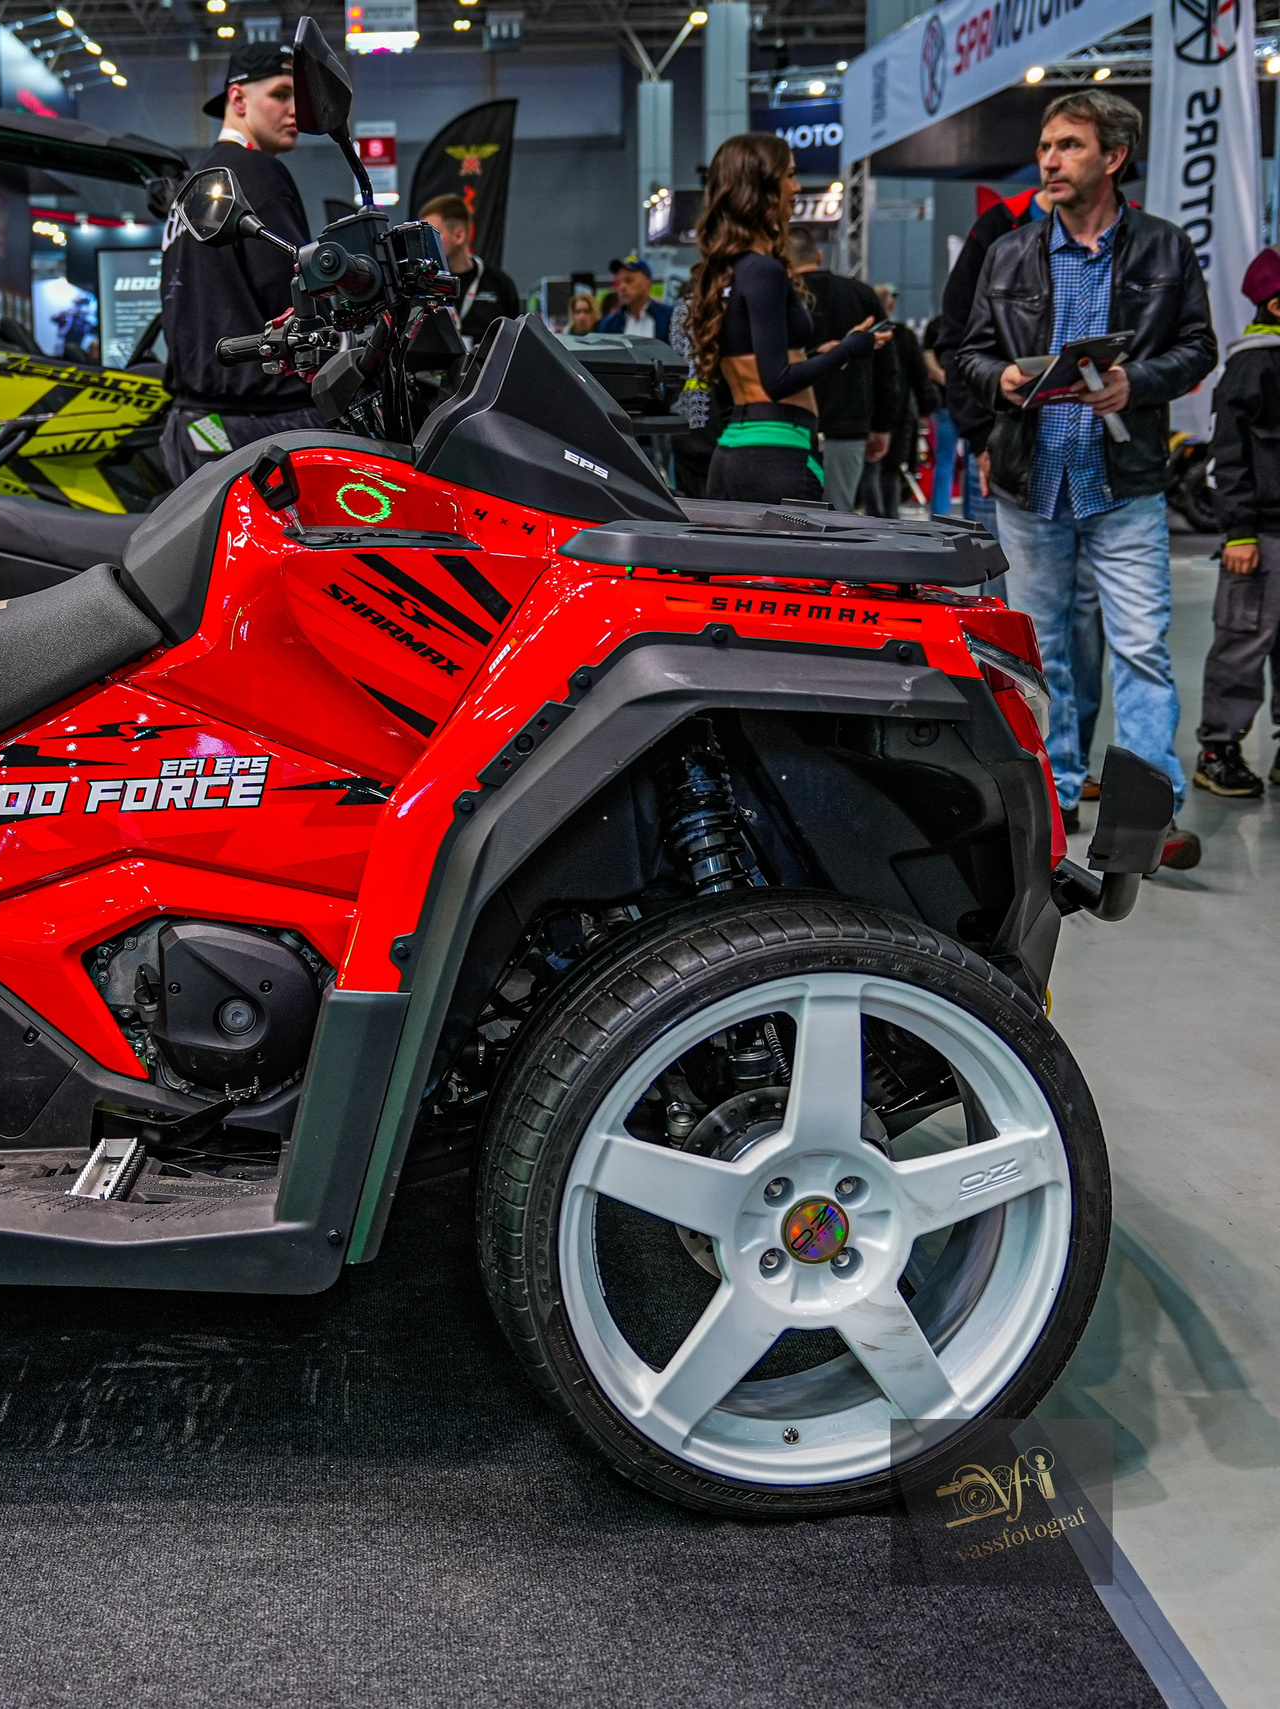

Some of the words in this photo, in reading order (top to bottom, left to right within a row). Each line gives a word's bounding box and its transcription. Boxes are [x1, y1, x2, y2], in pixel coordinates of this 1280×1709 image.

[954, 0, 1085, 74] SPRMOTO
[793, 200, 840, 216] OTO
[564, 449, 609, 480] EPS
[710, 597, 880, 625] SHARMAX
[321, 583, 464, 677] SHARMAX
[160, 758, 205, 778] EFI
[213, 756, 270, 776] EPS
[84, 774, 266, 814] FORCE
